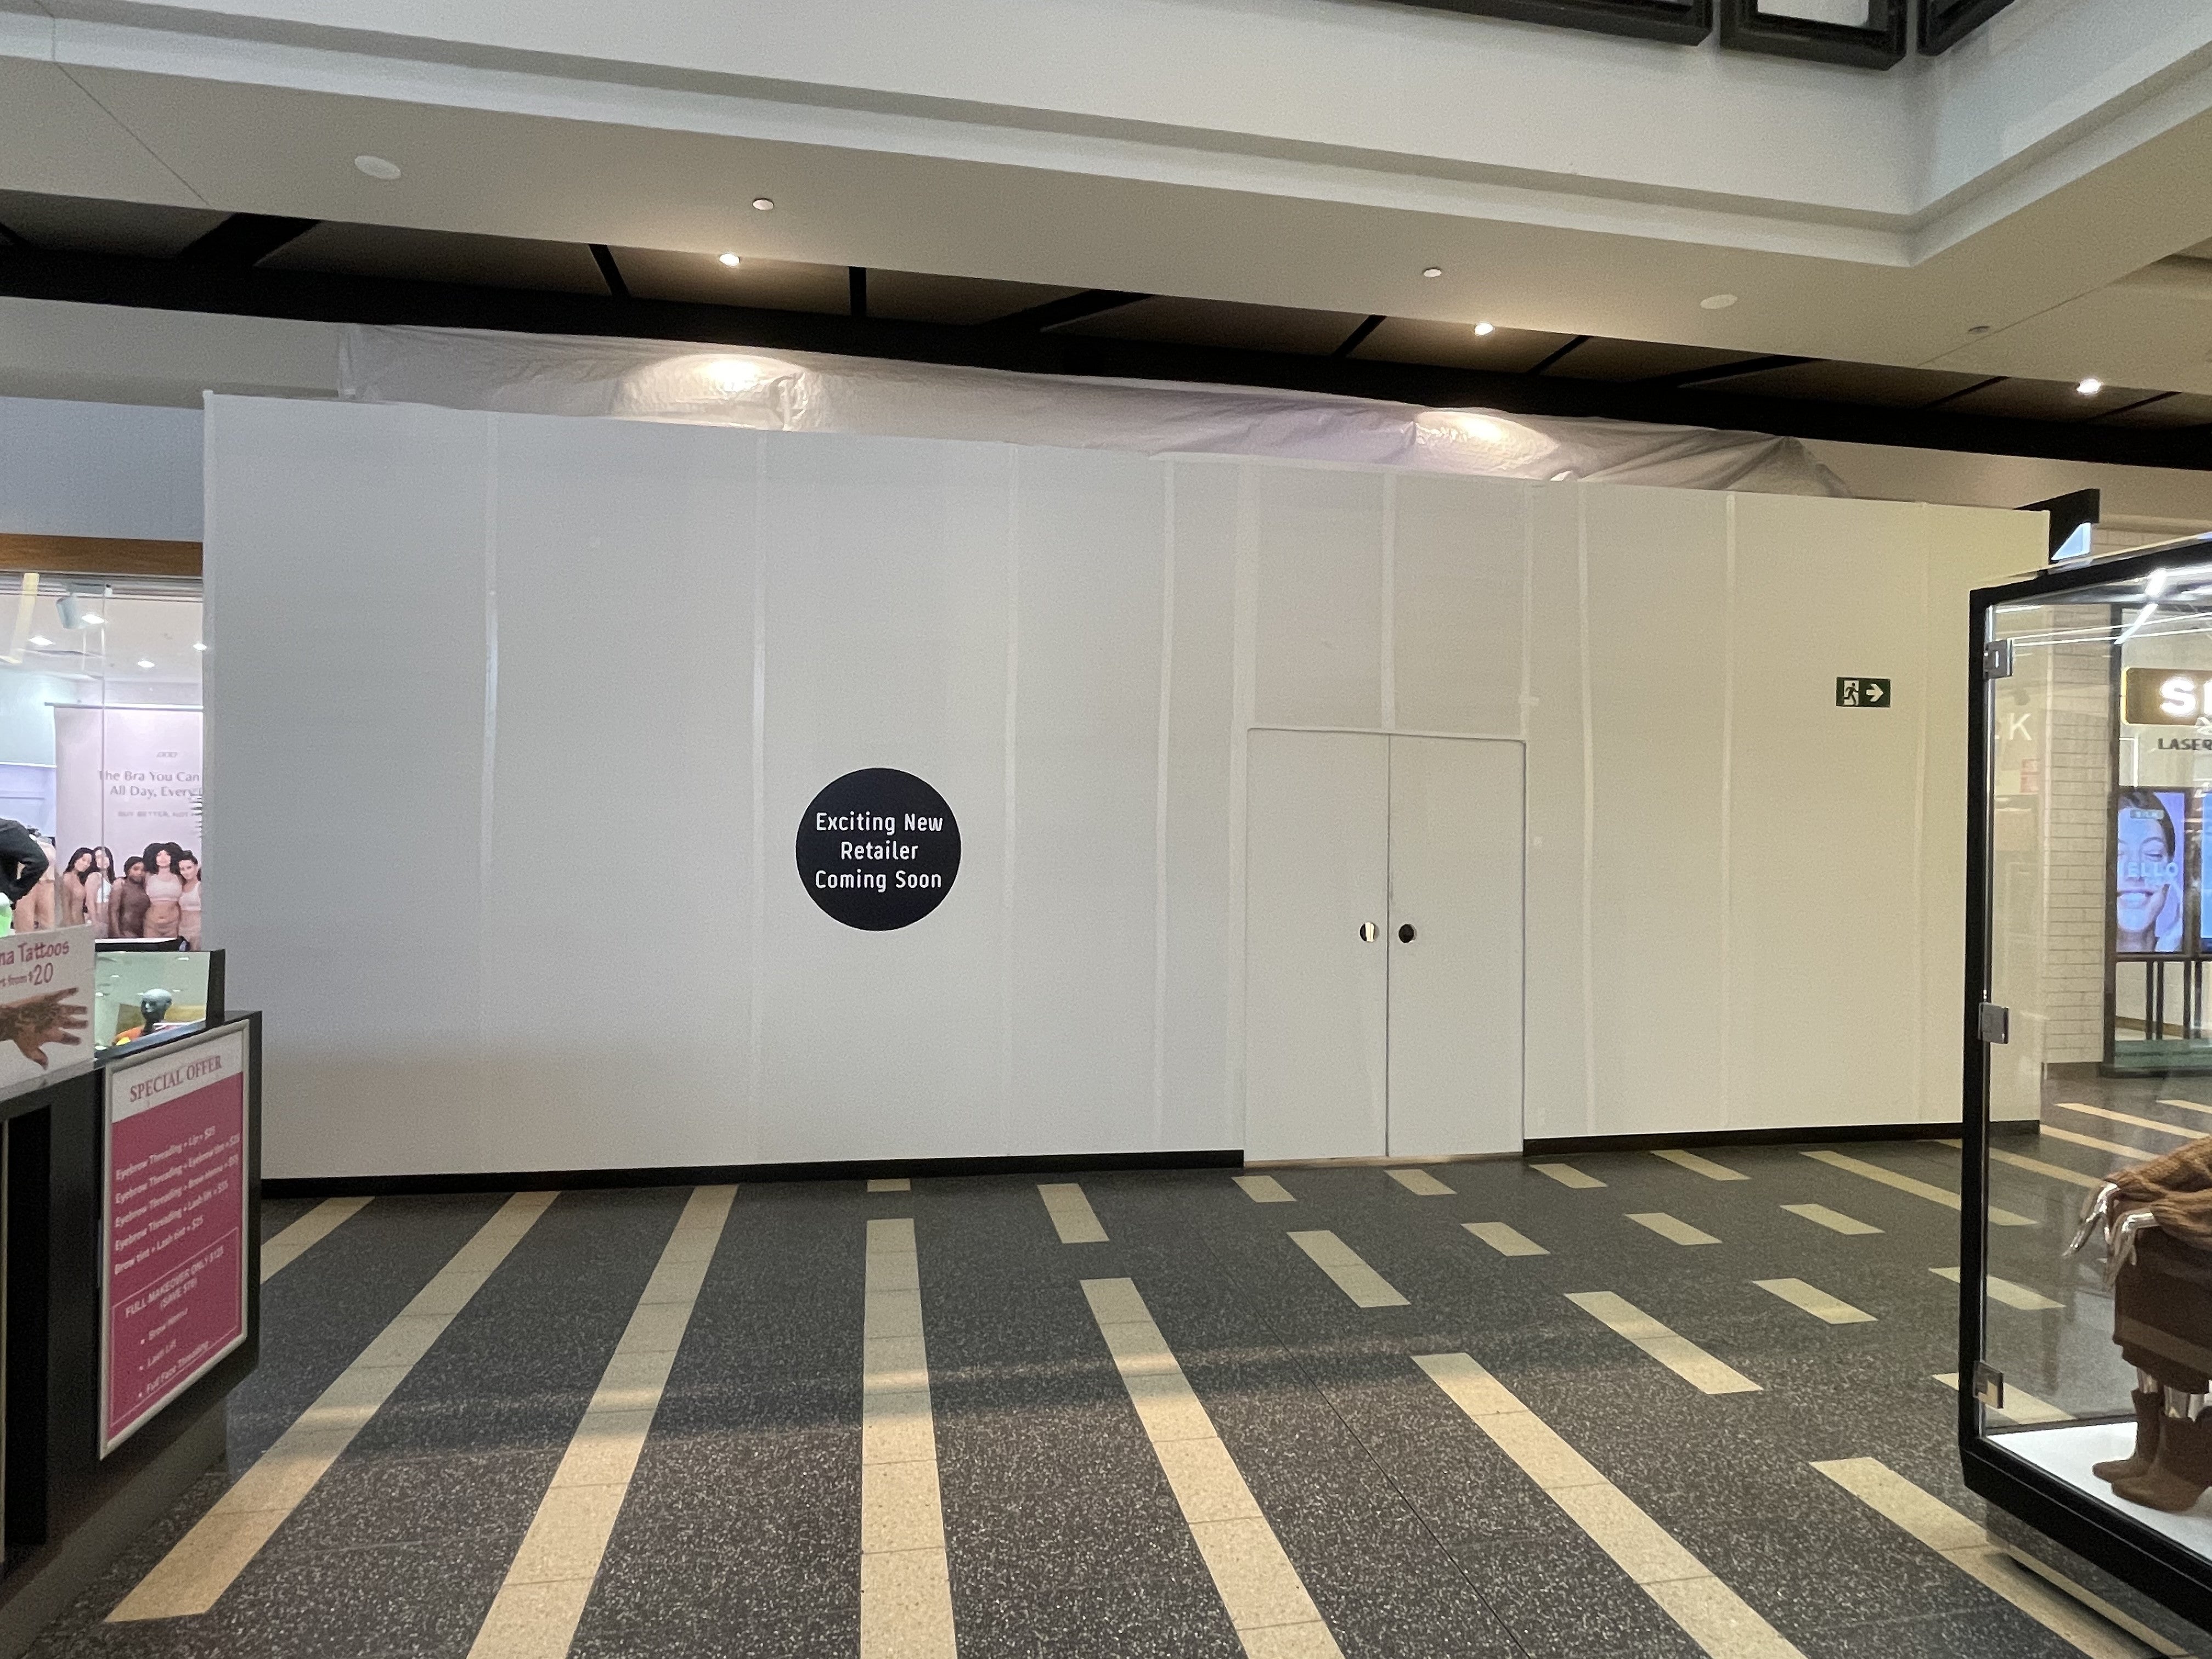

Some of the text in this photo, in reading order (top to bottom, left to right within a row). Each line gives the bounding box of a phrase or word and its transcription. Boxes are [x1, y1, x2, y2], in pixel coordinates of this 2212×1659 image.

[98, 770, 200, 781] The Bra You Can
[110, 786, 125, 795] All
[130, 786, 157, 799] Day,
[816, 811, 944, 836] Exciting New
[840, 840, 918, 860] Retailer
[815, 868, 941, 893] Coming Soon
[18, 941, 69, 962] Tattoos
[29, 962, 54, 985] $20
[130, 1055, 222, 1103] SPECIAL OFFER
